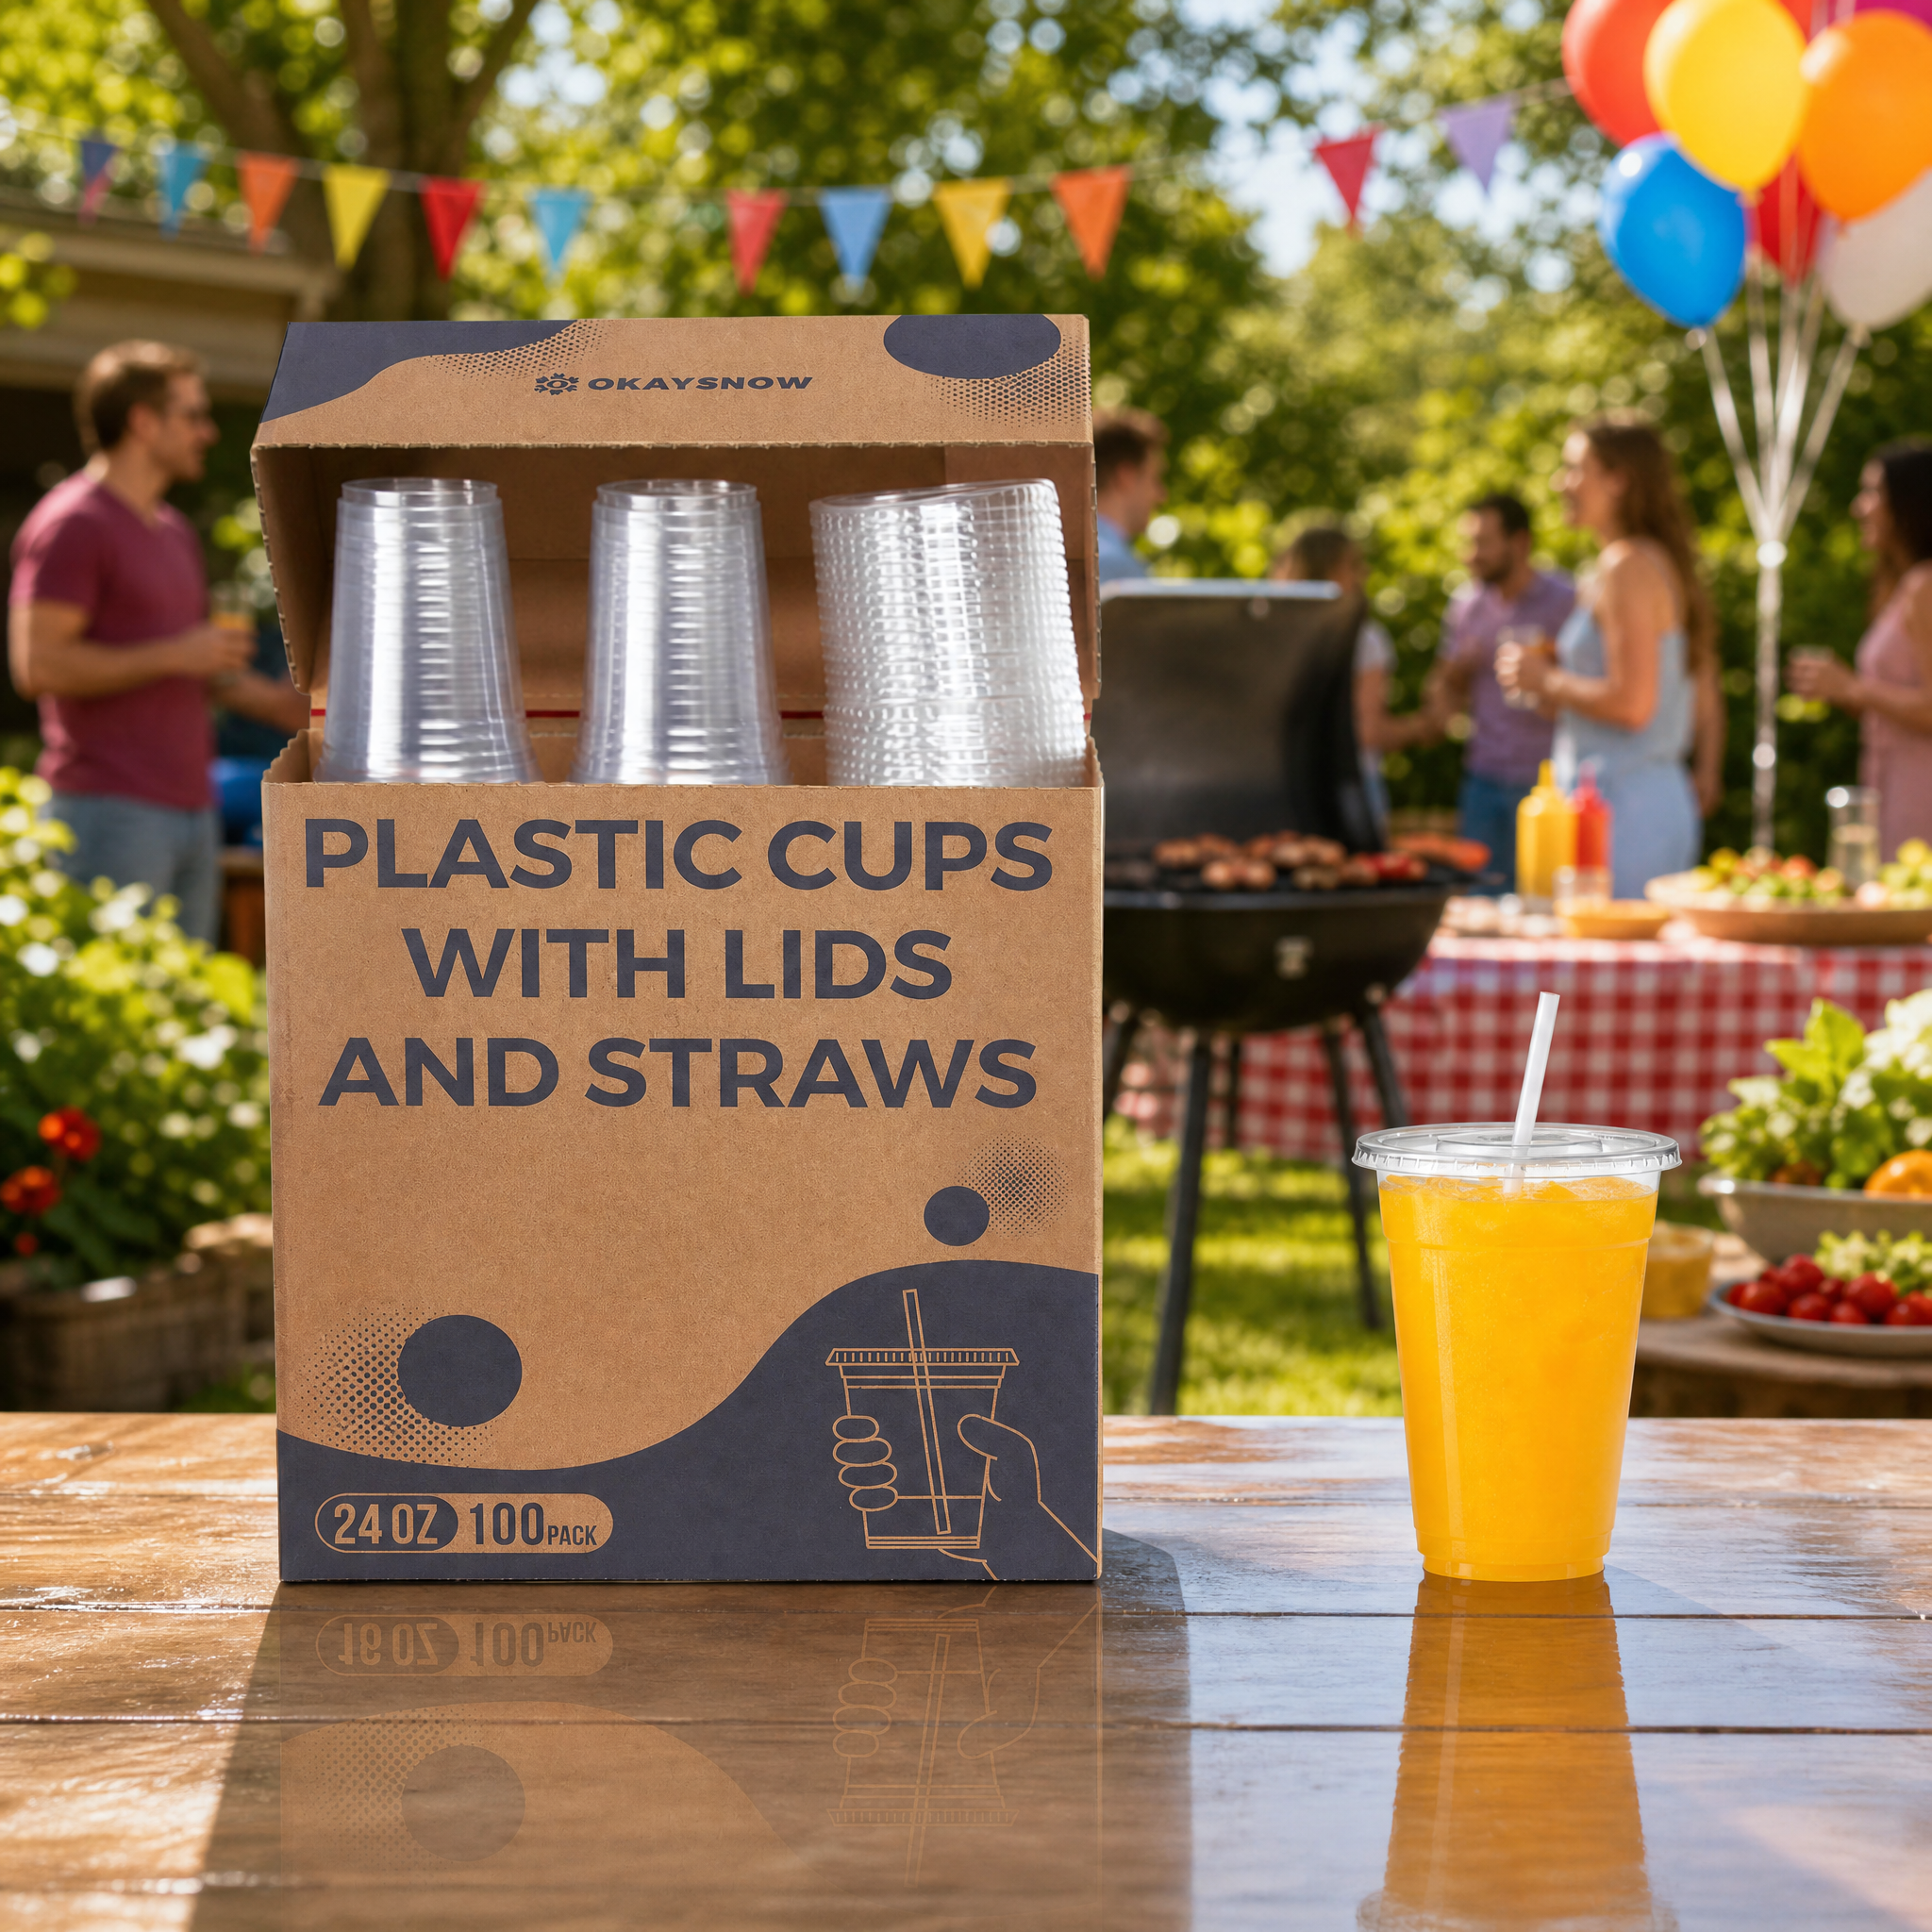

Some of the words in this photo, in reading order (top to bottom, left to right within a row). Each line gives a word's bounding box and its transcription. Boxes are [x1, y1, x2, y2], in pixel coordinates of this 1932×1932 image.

[588, 376, 813, 391] OKAYSNOW
[305, 818, 742, 891] PLASTIC
[767, 820, 1054, 891] CUPS
[401, 927, 686, 999] WITH
[724, 929, 953, 1000] LIDS
[318, 1037, 559, 1108] AND
[584, 1037, 1038, 1108] STRAWS
[334, 1503, 383, 1545] 24
[391, 1503, 439, 1545] OZ
[469, 1502, 545, 1546] 100
[547, 1524, 598, 1546] PACK
